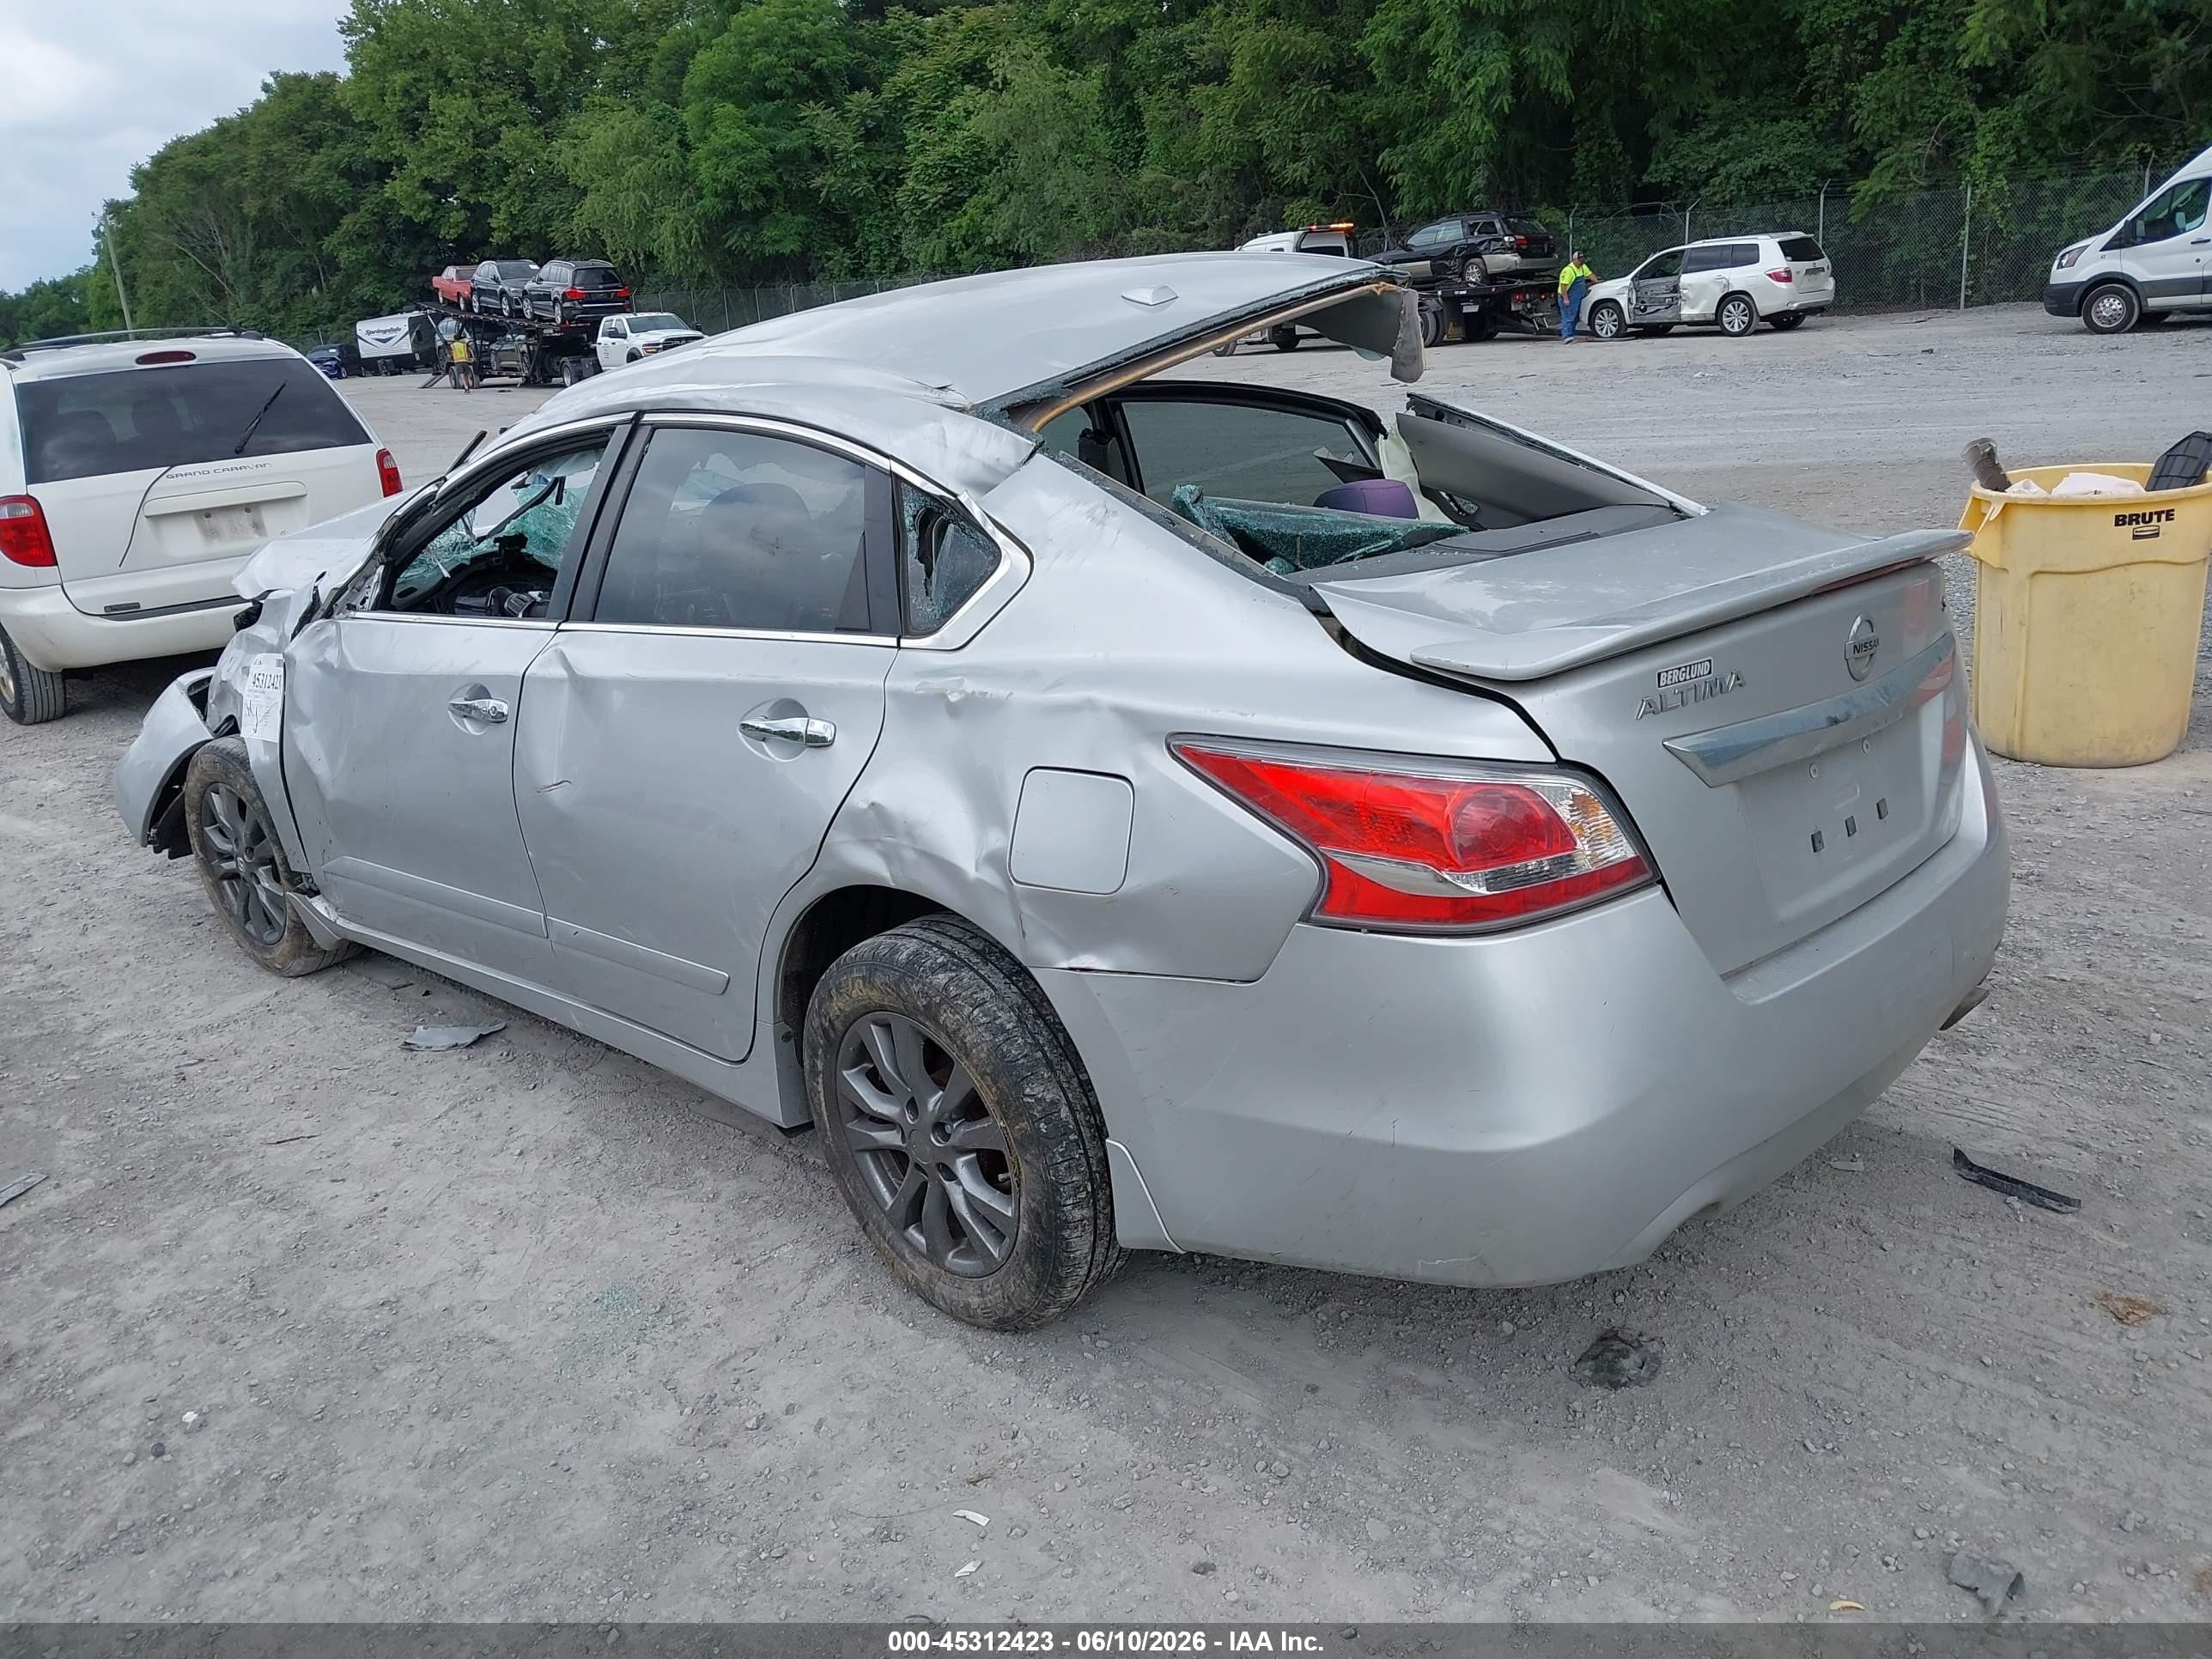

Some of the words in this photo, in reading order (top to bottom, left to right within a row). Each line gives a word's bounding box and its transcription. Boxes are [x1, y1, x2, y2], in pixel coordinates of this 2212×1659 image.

[166, 470, 210, 479] GRAND
[213, 463, 272, 474] CARAVAN
[2114, 508, 2175, 527] BRUTE
[1659, 660, 1711, 687] BERGLUND
[1635, 669, 1747, 720] ALTIMA
